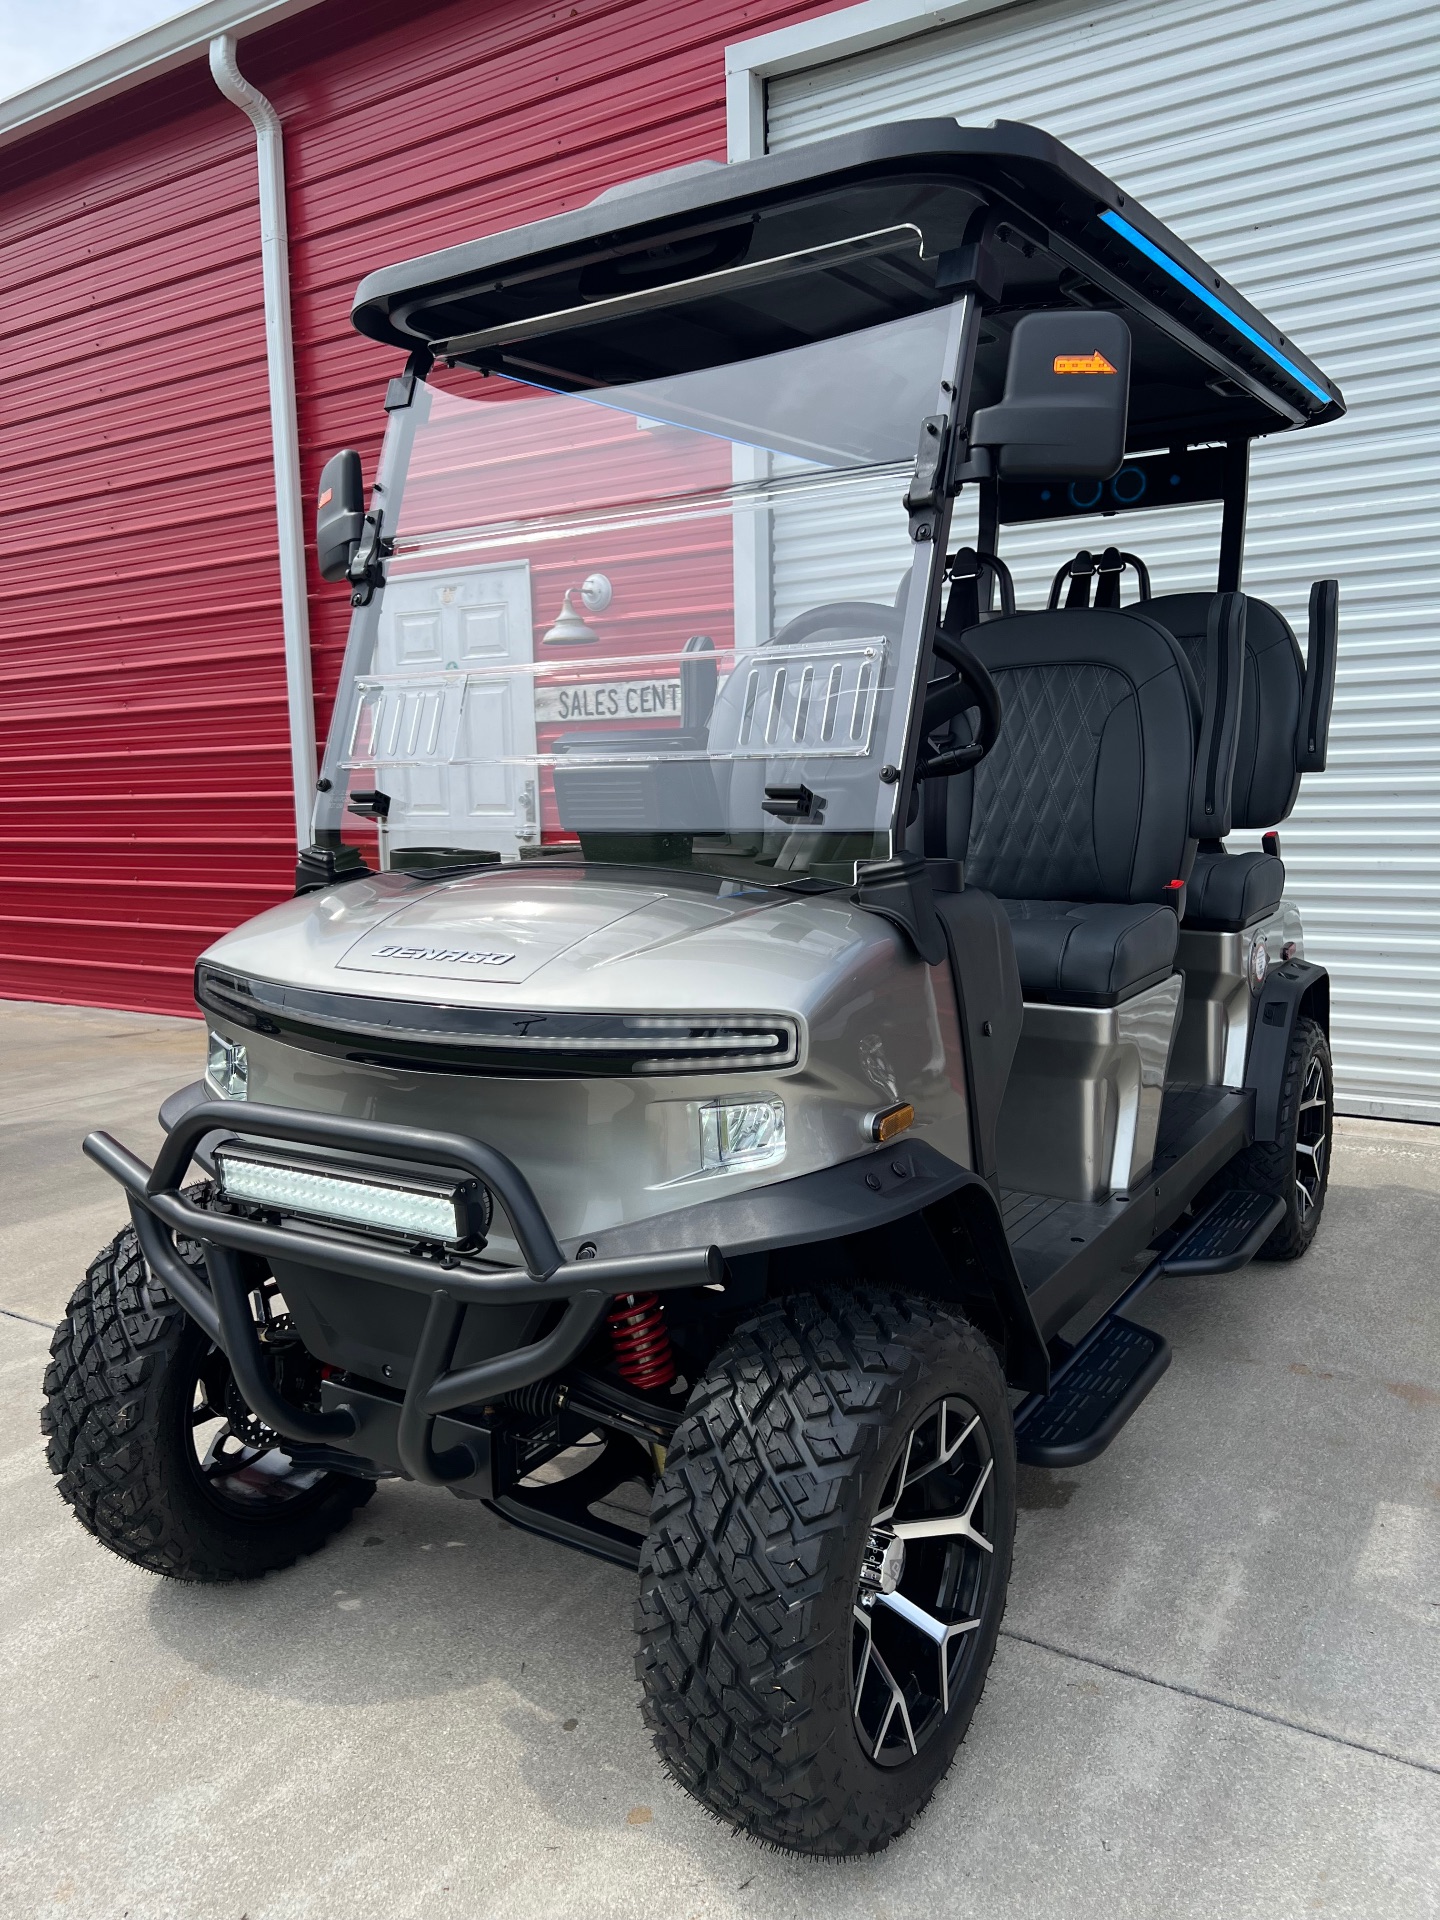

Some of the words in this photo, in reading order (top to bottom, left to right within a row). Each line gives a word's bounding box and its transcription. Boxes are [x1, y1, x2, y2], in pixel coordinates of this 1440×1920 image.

[558, 689, 618, 719] SALES
[626, 684, 680, 713] CENT
[371, 945, 516, 965] DENAGO
